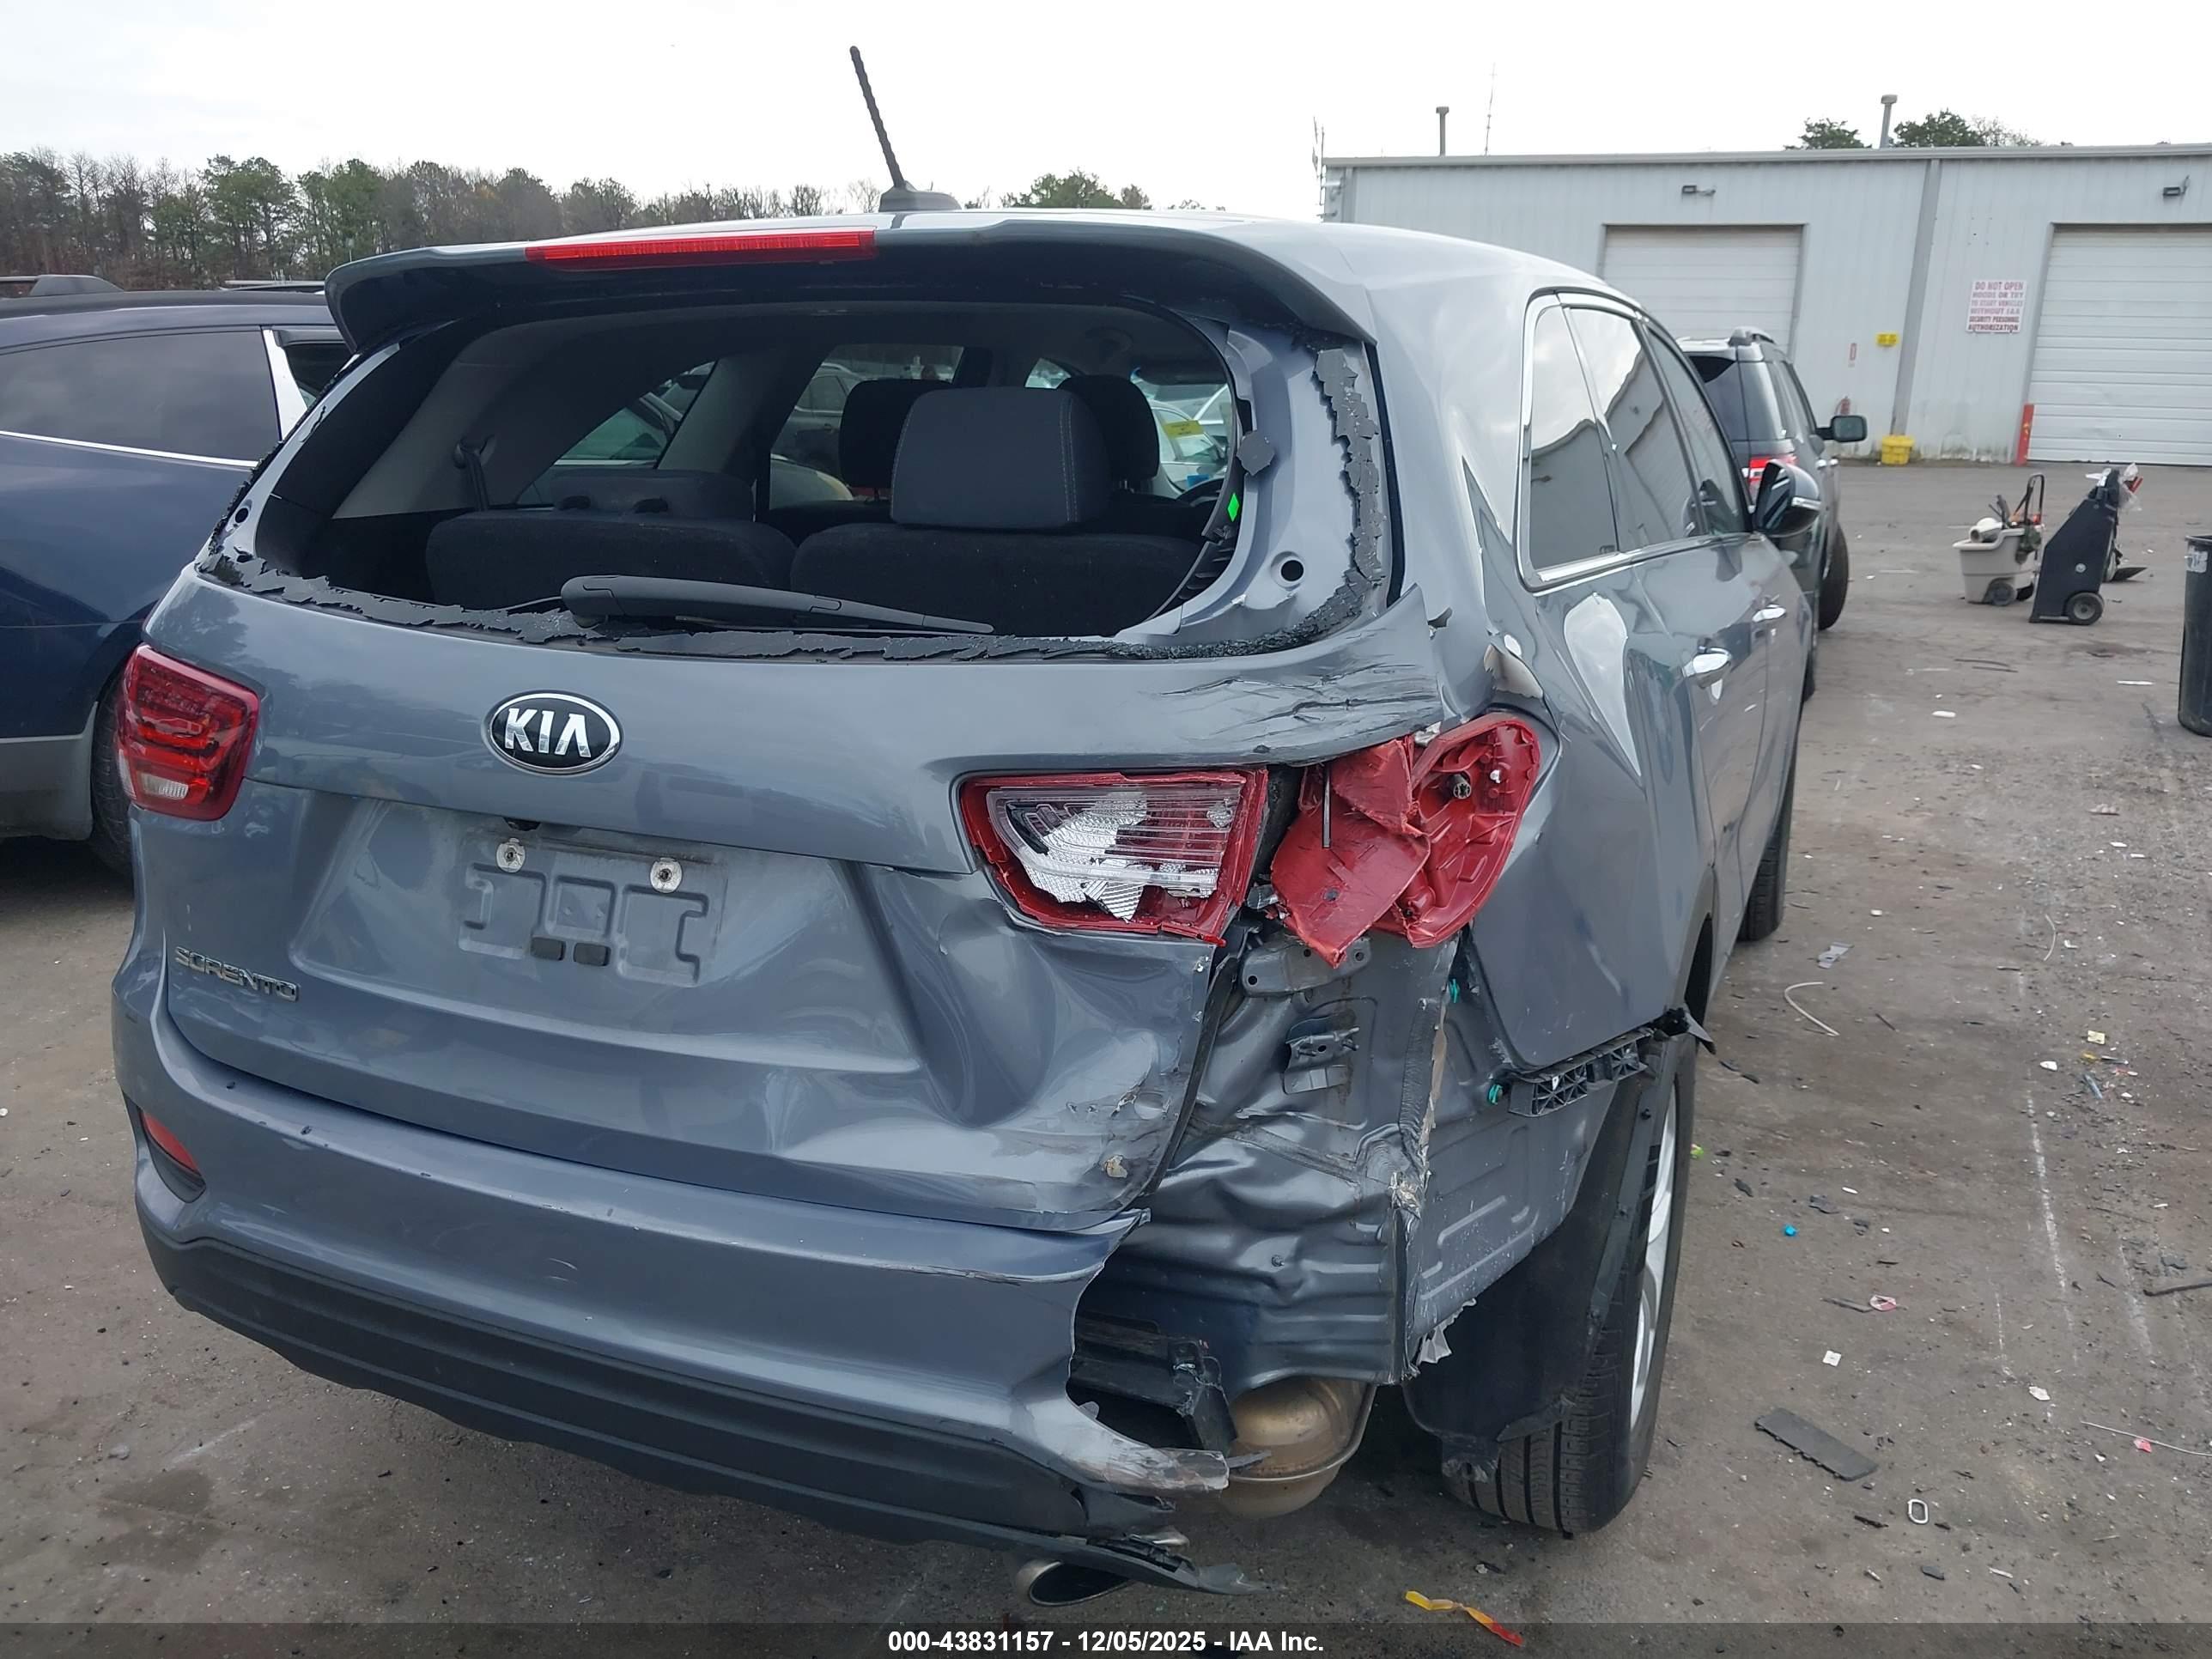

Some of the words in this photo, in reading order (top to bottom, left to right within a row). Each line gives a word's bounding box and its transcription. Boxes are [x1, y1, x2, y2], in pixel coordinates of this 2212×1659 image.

[1975, 282, 1986, 290] DO
[1987, 282, 2002, 290] NOT
[2004, 282, 2024, 290] OPEN
[504, 708, 592, 758] KIA
[174, 946, 298, 1002] SORENTO
